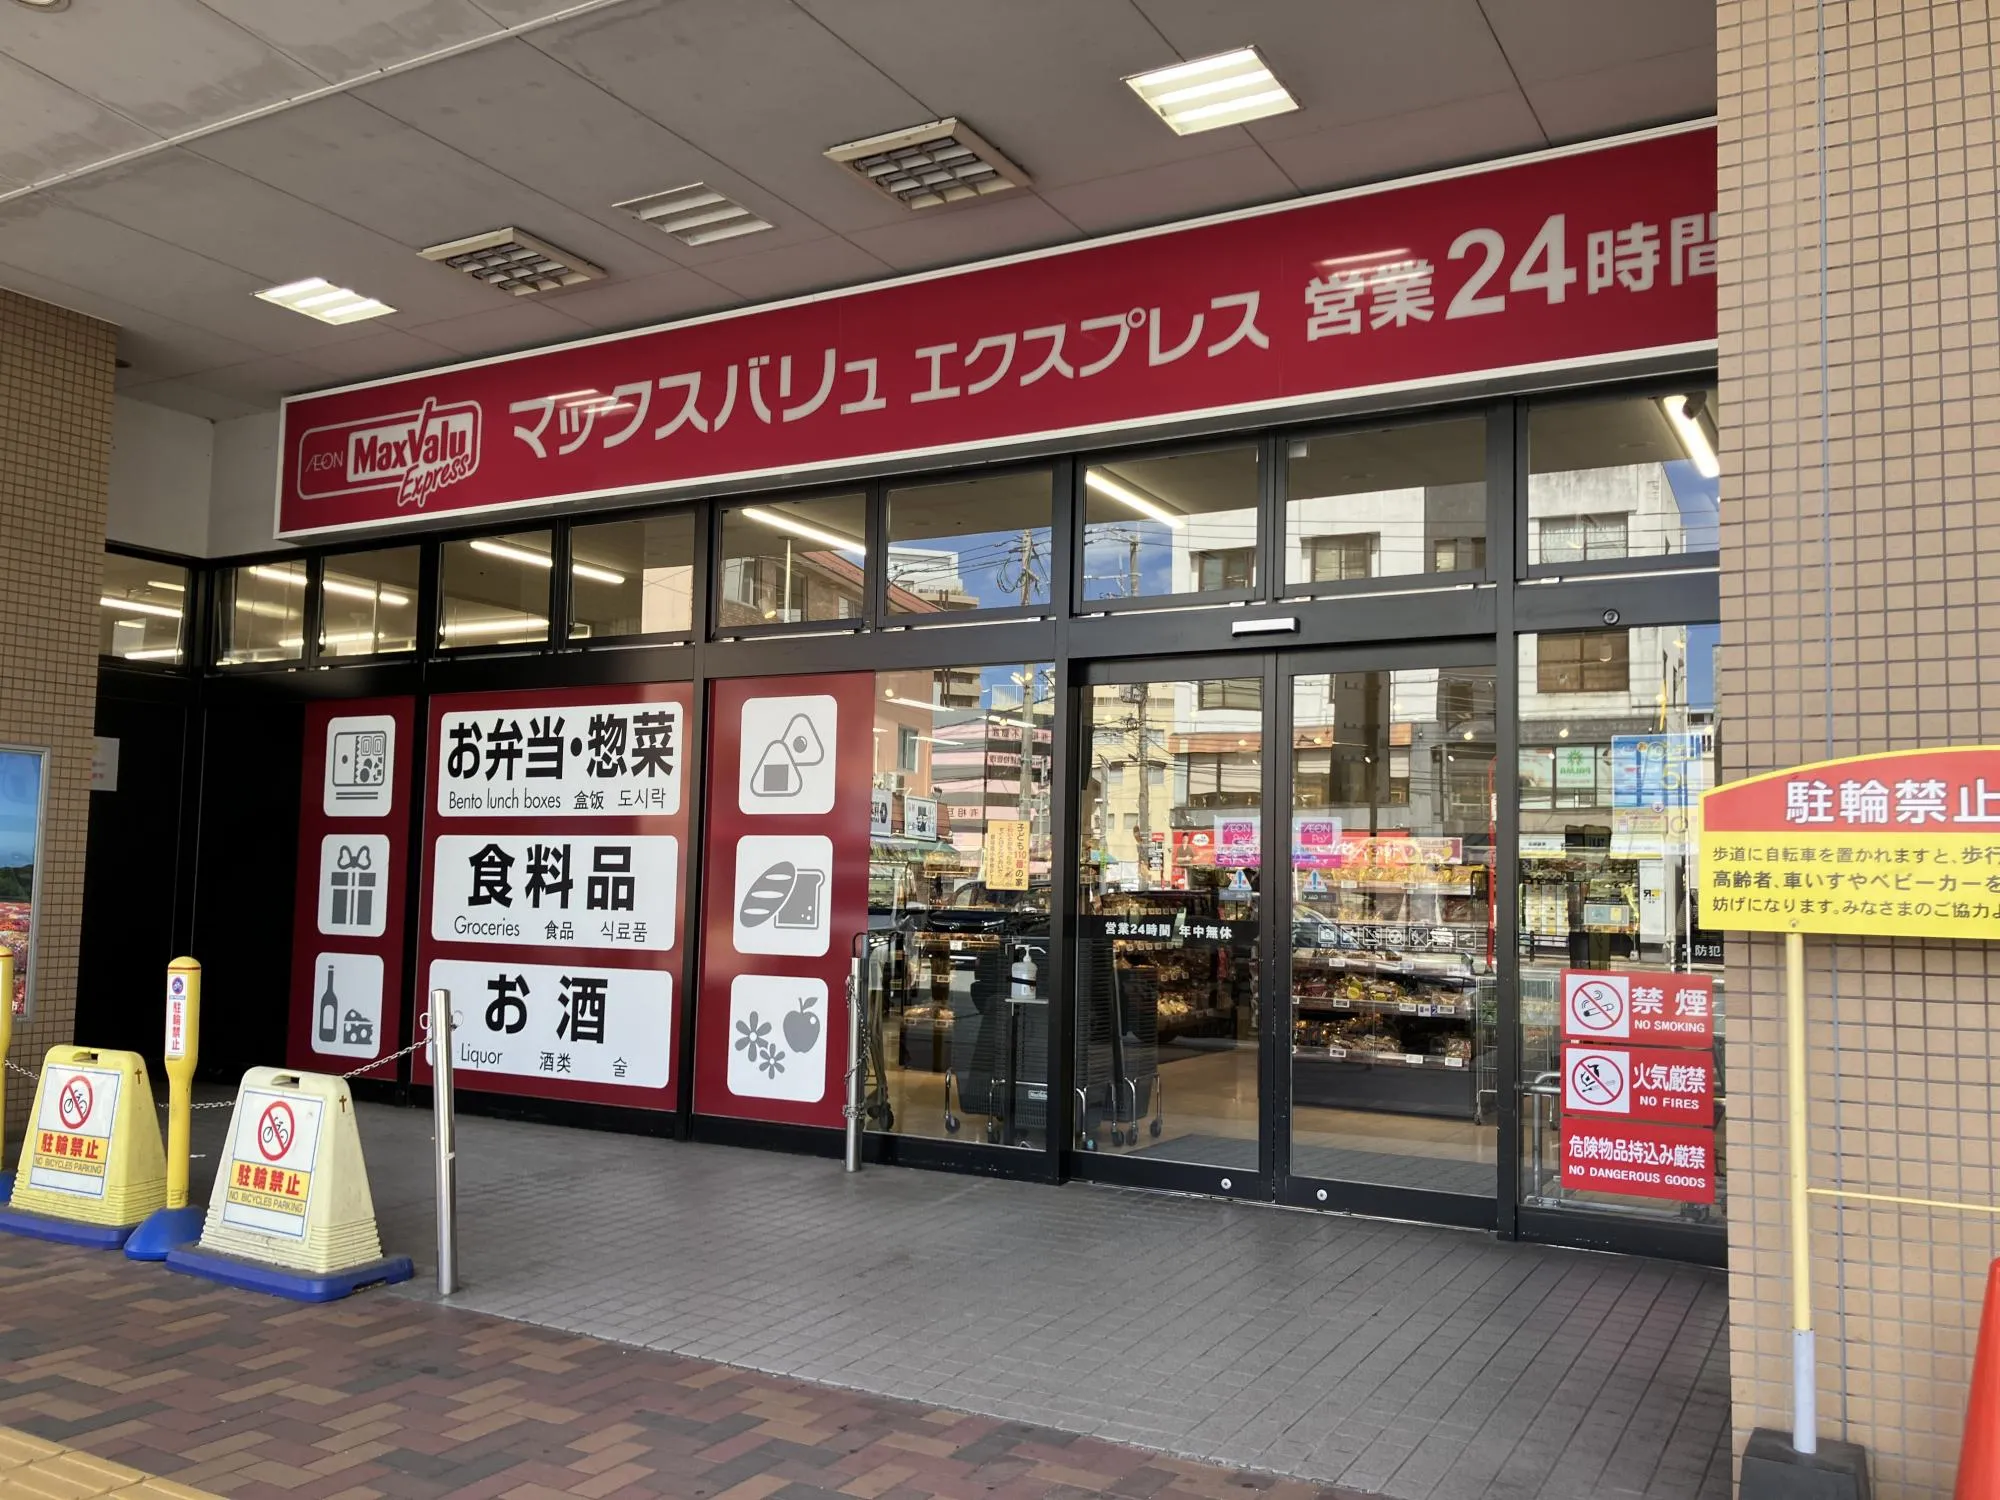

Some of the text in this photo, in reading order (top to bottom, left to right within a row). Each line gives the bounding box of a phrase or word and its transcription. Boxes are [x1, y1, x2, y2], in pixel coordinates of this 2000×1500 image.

[509, 348, 887, 459] マックスバリュ
[910, 290, 1270, 404] エクスプレス
[352, 399, 469, 475] MaxValu
[398, 455, 472, 506] Express
[447, 711, 676, 781] お弁当・惣菜
[449, 787, 667, 810] Bento lunch boxes 盒饭 도시락
[1785, 778, 2000, 825] 駐輪禁止
[467, 843, 636, 911] 食料品
[454, 915, 648, 942] Groceries 食品 식료품
[1105, 922, 1232, 939] 営業24時間 年中無休
[1695, 944, 1721, 957] 防犯
[485, 973, 609, 1044] お酒
[1631, 986, 1708, 1017] 禁煙
[1634, 1019, 1705, 1033] NO SMOKING
[460, 1043, 629, 1077] Liquor 酒类 술
[1632, 1062, 1706, 1093] 火気厳禁
[1639, 1095, 1700, 1110] NO FIRES
[41, 1132, 99, 1159] 駐輪禁止
[1568, 1134, 1706, 1169] 危険物品持込み厳禁
[73, 1162, 102, 1174] PARKING
[237, 1163, 301, 1196] 駐輪禁止
[1568, 1164, 1706, 1188] NO DANGEROUS GOODS
[229, 1190, 239, 1201] NO
[272, 1199, 303, 1214] PARKING
